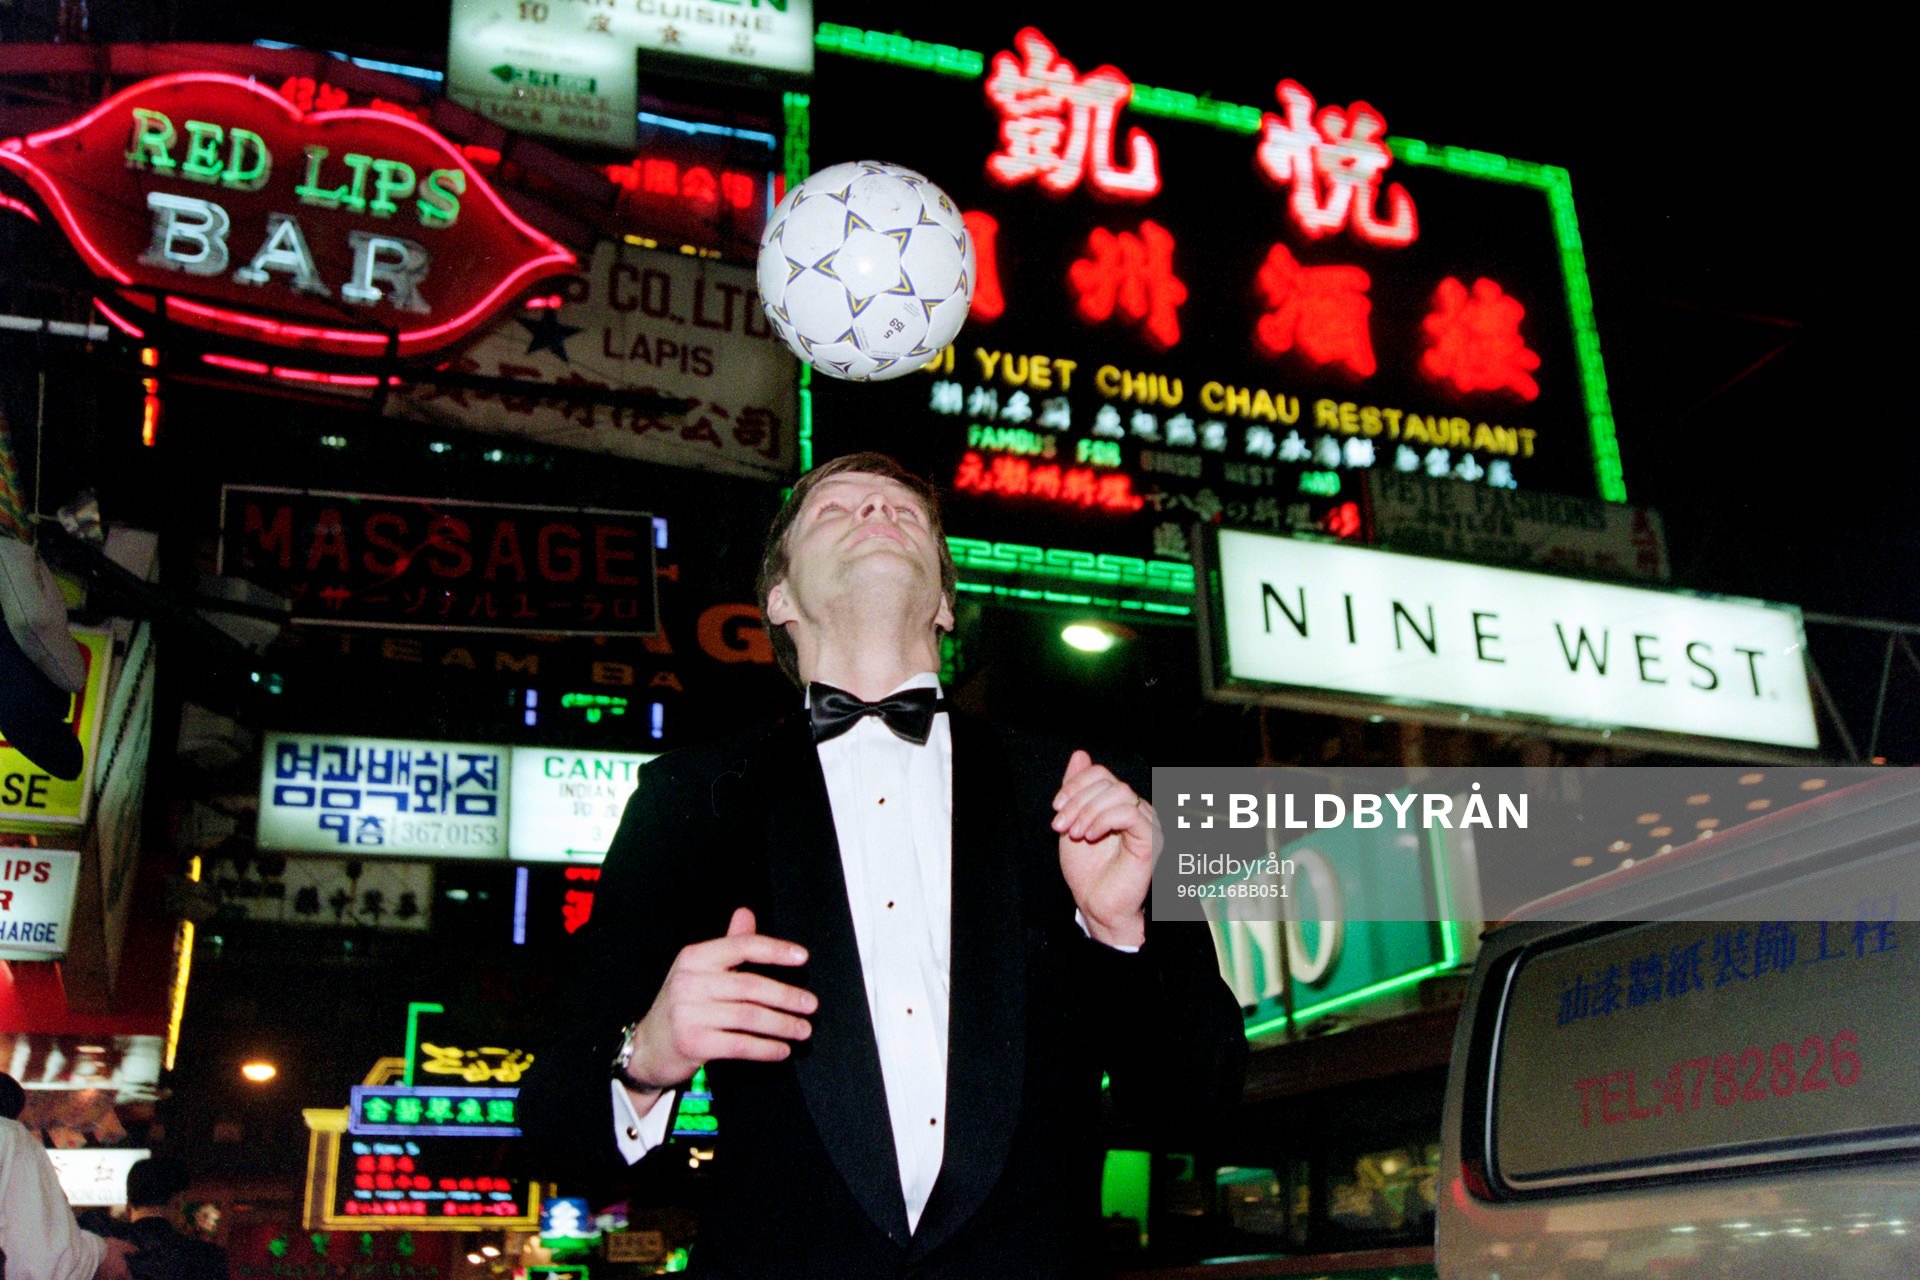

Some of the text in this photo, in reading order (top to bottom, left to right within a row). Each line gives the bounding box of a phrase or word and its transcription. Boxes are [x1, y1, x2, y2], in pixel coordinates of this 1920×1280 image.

[125, 107, 467, 227] RED LIPS
[138, 191, 432, 314] BAR
[603, 327, 715, 378] LAPIS
[975, 347, 1078, 392] YUET
[1095, 364, 1184, 407] CHIU
[1200, 381, 1300, 425] CHAU
[1313, 398, 1538, 457] RESTAURANT
[244, 504, 640, 586] MASSAGE
[1261, 582, 1766, 698] NINE WEST
[273, 741, 499, 817] 영광백화점
[1573, 1029, 1862, 1129] TEL:4782826
